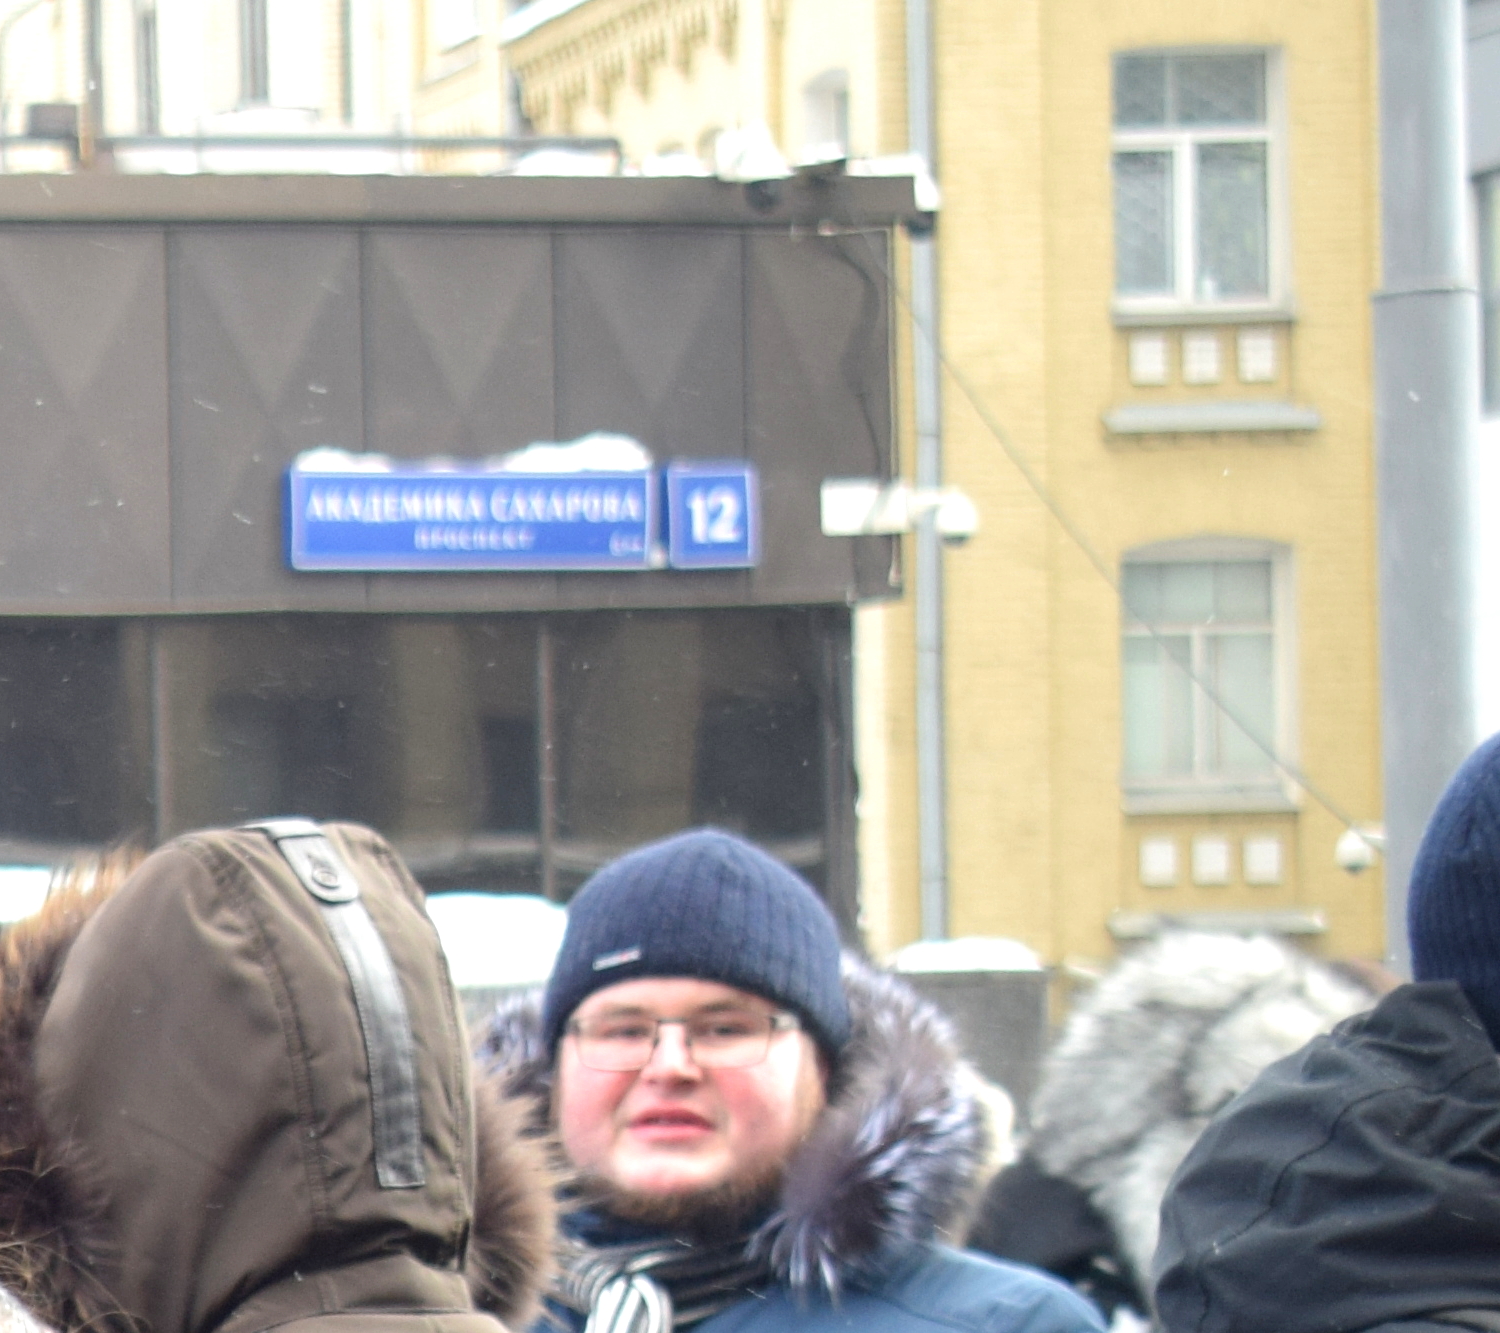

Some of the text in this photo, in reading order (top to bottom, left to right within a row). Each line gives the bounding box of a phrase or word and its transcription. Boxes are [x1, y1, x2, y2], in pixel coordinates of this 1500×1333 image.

[305, 485, 644, 523] АКАДЕМИКА САХАРОВА
[687, 486, 743, 544] 12
